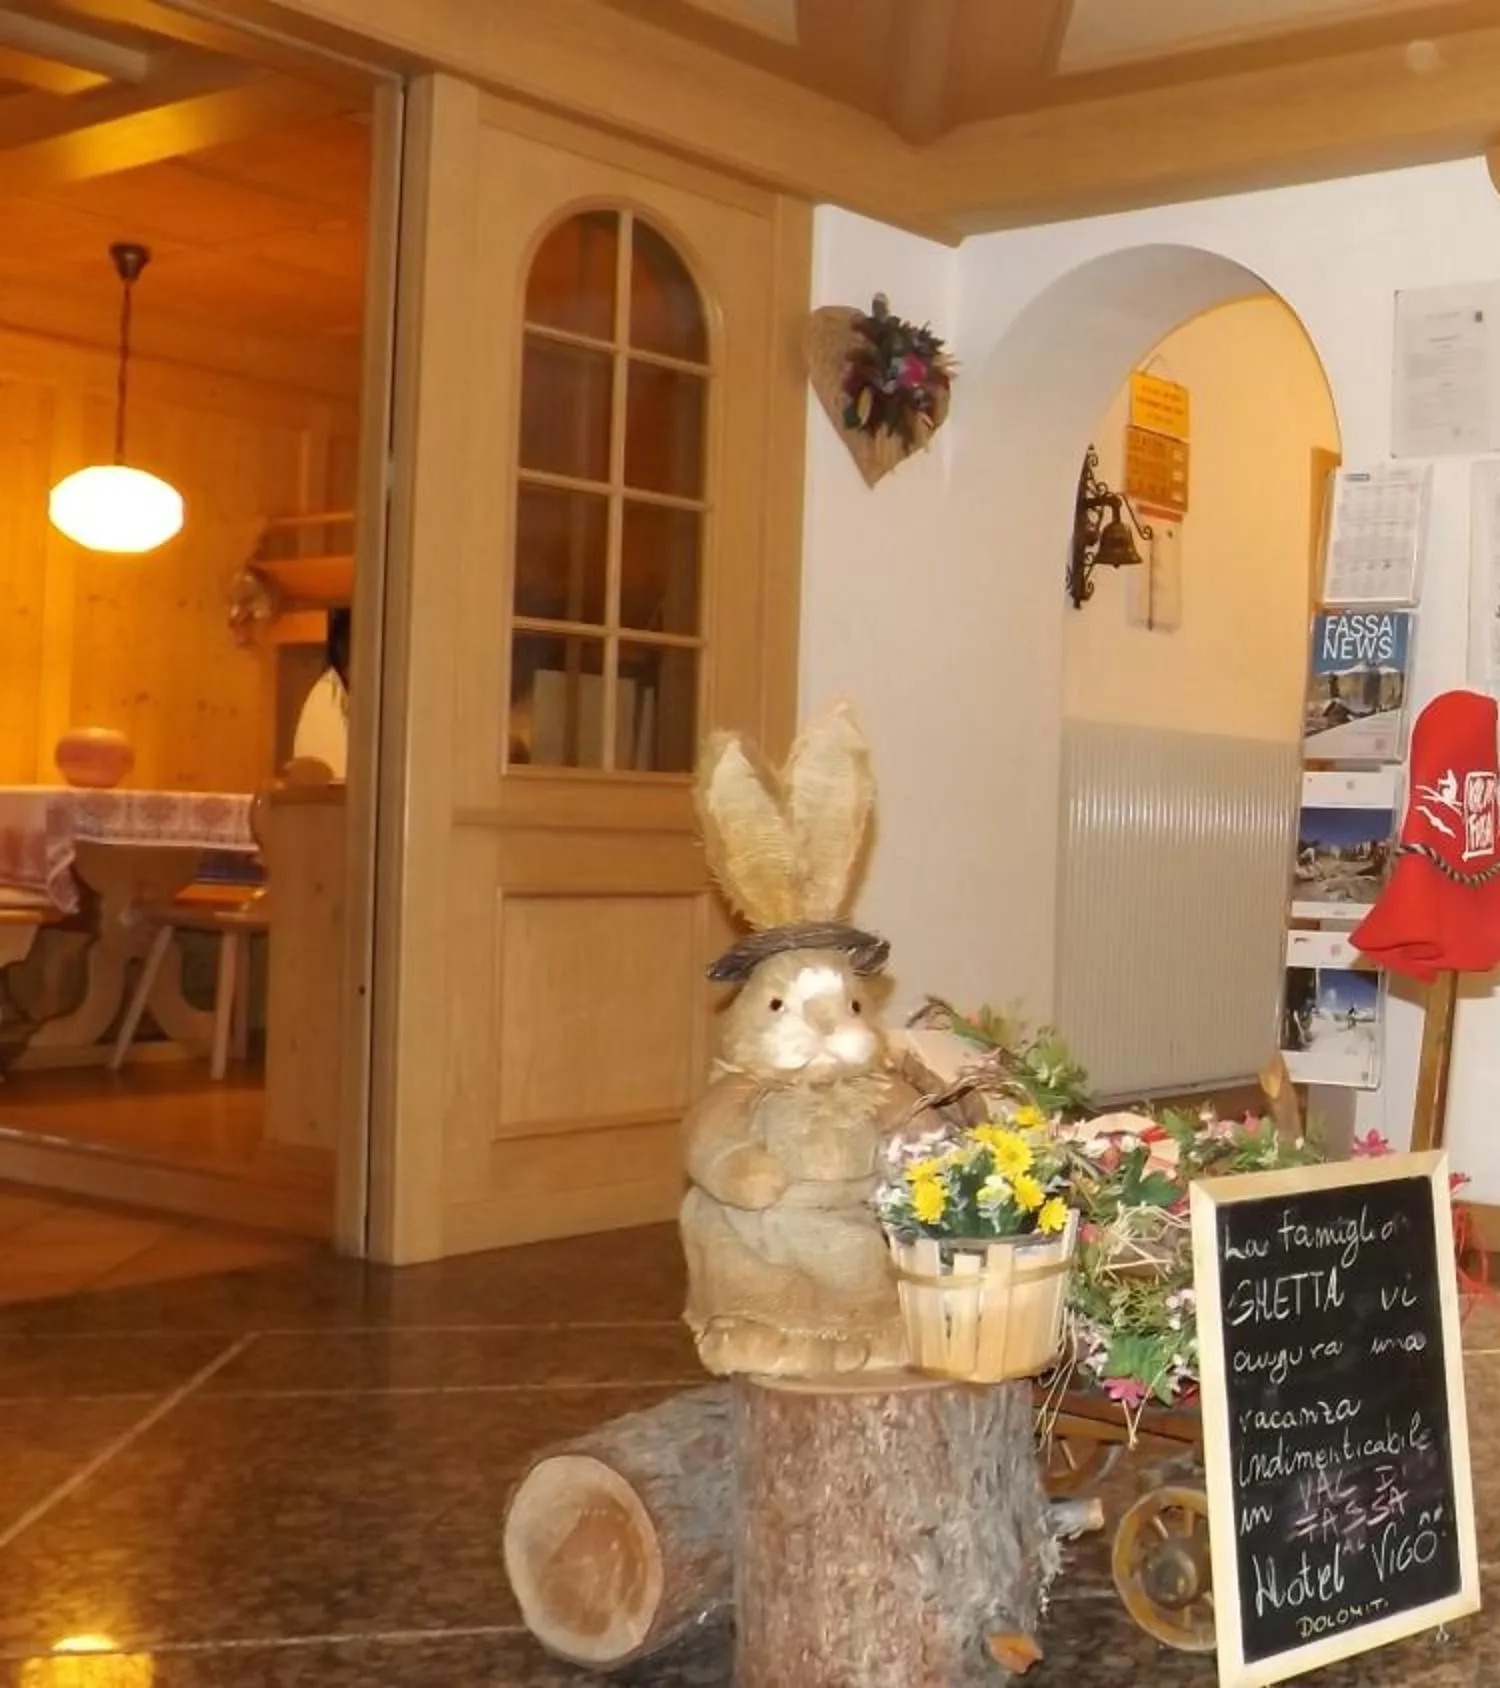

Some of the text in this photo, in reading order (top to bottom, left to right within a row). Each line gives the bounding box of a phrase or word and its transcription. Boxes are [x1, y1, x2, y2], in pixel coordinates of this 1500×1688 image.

[1325, 615, 1393, 637] FASSA
[1322, 637, 1393, 660] NEWS
[1225, 1223, 1269, 1260] La
[1227, 1266, 1417, 1326] GHETTA vi
[1233, 1340, 1344, 1385] augura
[1239, 1398, 1361, 1433] vacanza
[1239, 1410, 1432, 1487] indimenticabile
[1240, 1504, 1273, 1536] in
[1252, 1542, 1345, 1618] Hotel
